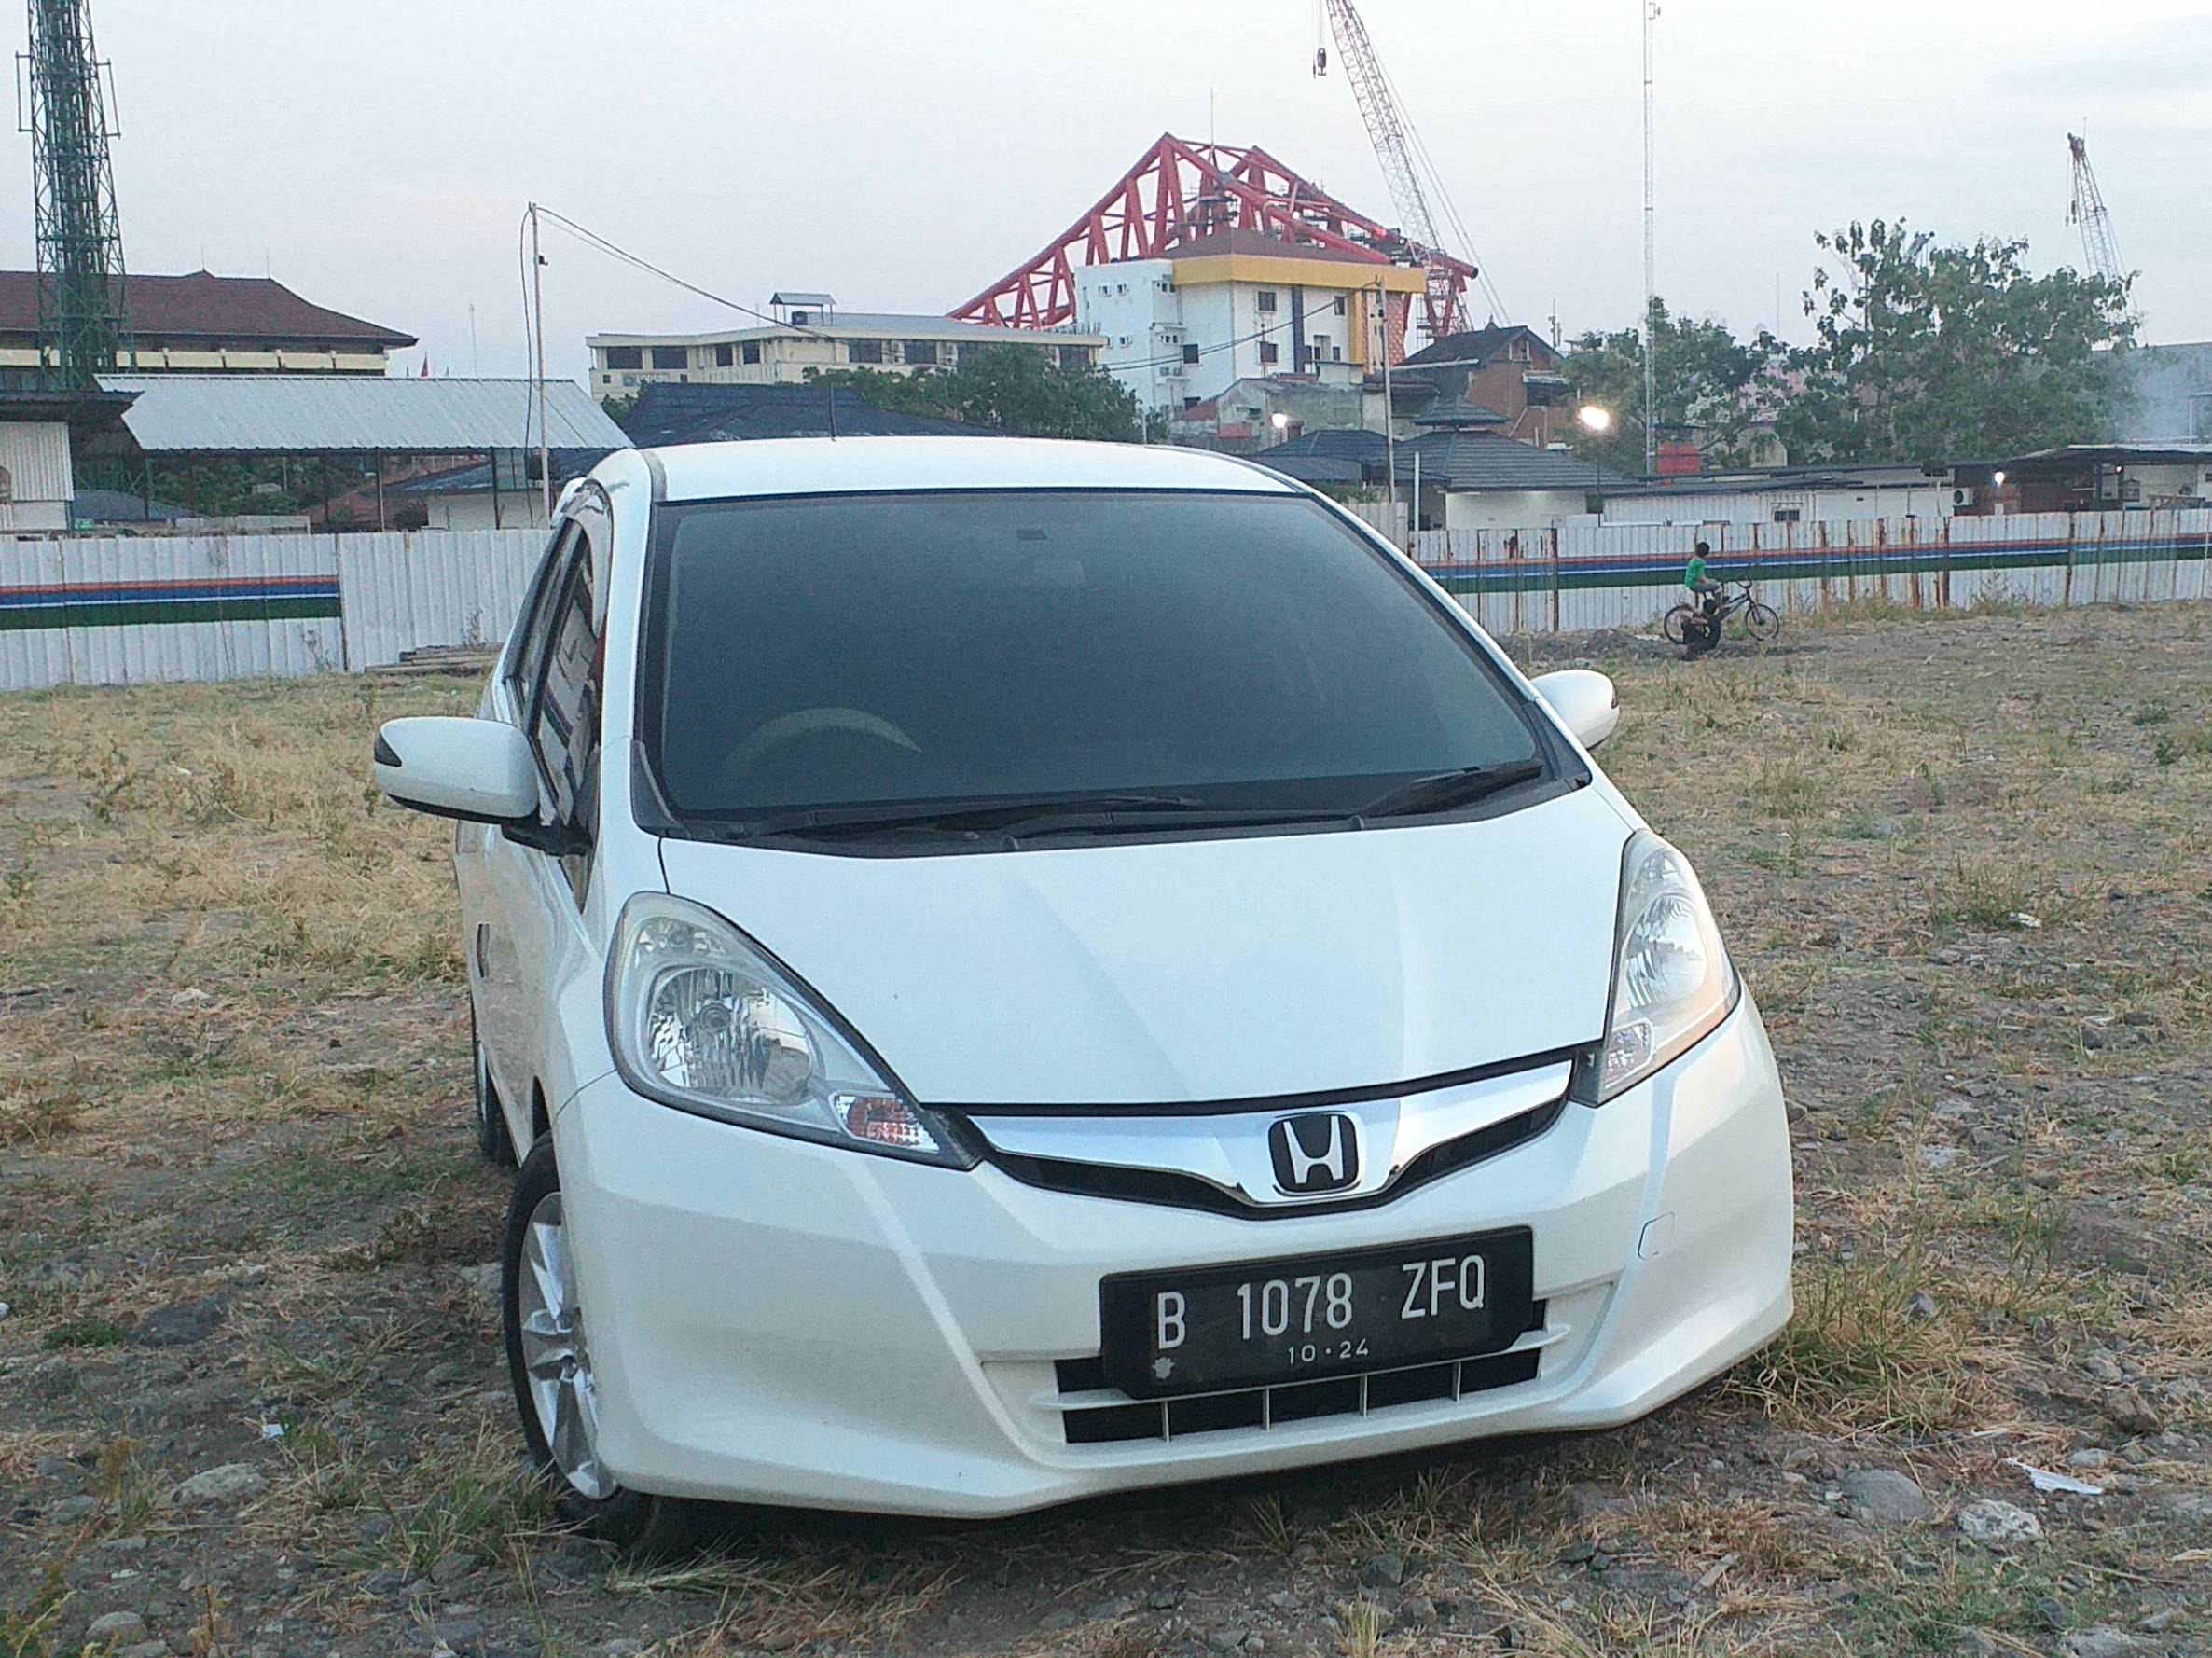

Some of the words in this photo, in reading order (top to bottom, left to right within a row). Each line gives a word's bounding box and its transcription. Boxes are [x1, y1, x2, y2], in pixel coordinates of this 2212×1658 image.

[1157, 1292, 1186, 1349] B
[1237, 1272, 1352, 1340] 1078
[1401, 1254, 1485, 1319] ZFQ
